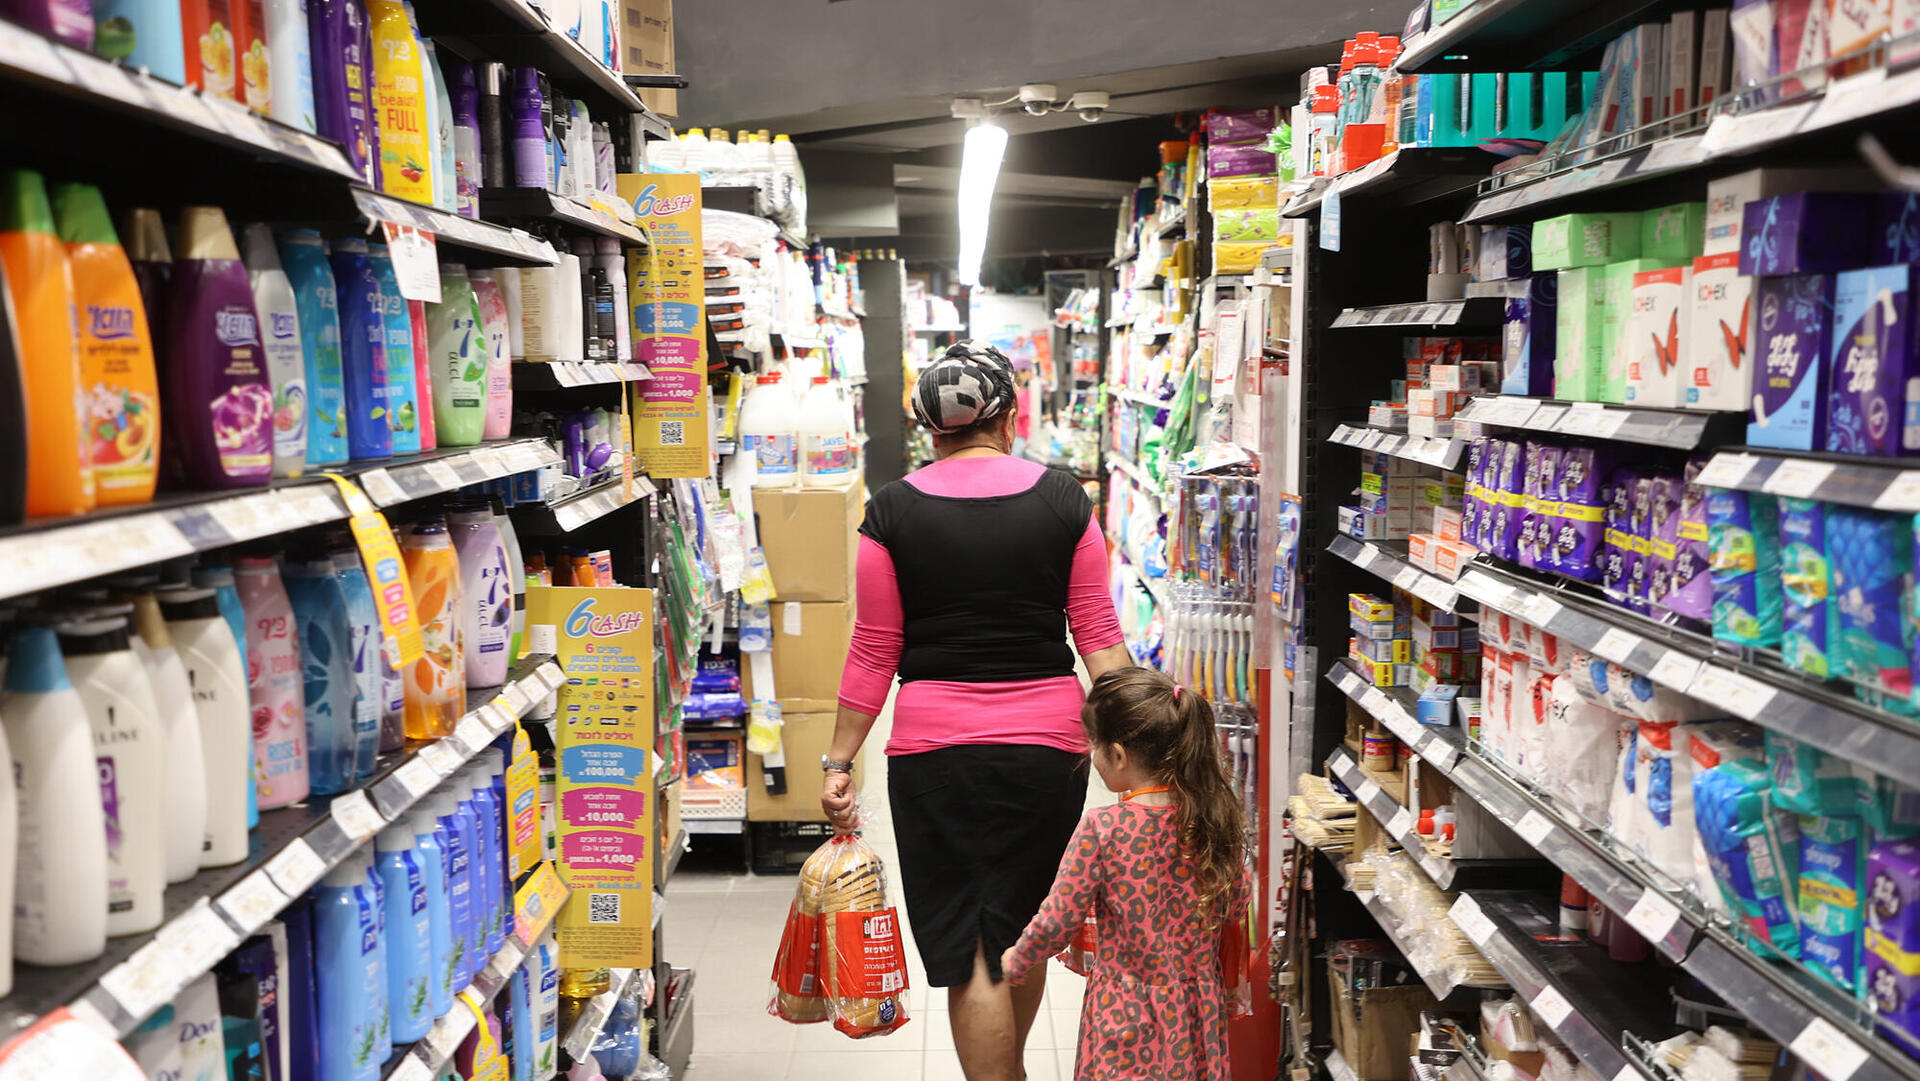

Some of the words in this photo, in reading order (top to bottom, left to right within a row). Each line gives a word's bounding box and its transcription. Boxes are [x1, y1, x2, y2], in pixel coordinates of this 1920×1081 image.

[387, 109, 420, 134] FULL
[650, 222, 656, 230] 6
[586, 643, 593, 654] 6
